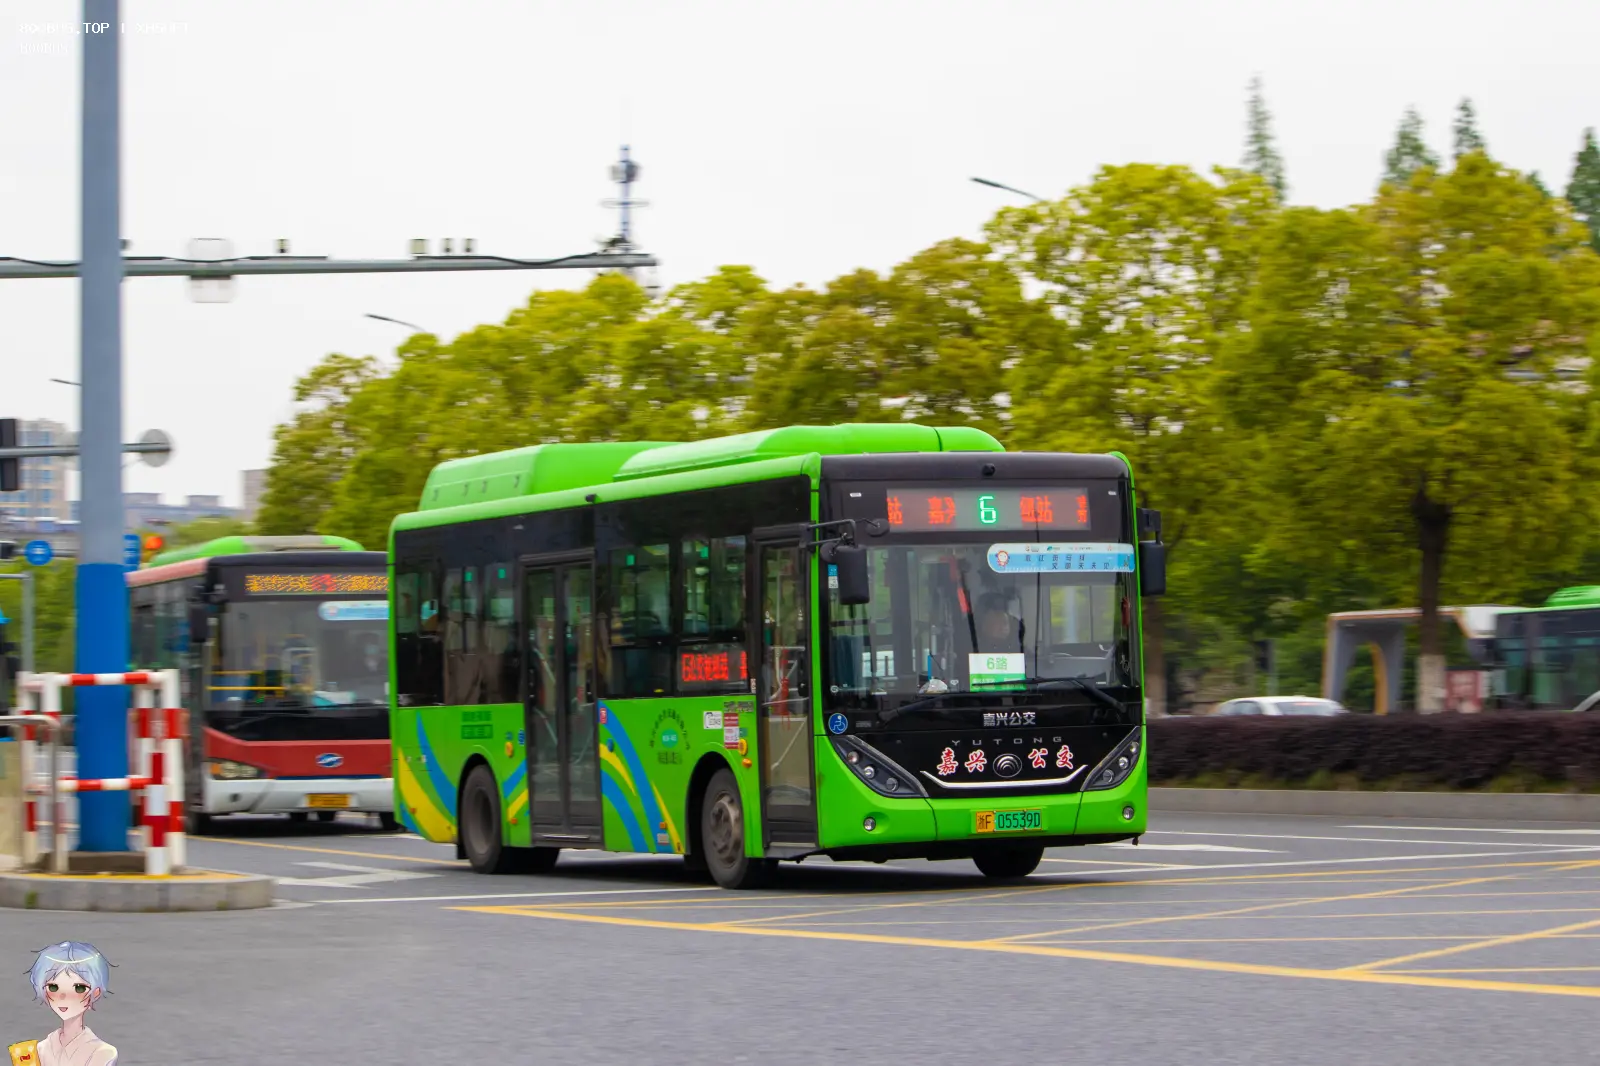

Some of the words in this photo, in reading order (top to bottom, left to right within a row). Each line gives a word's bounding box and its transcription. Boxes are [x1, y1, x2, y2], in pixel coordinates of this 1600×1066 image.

[979, 495, 997, 524] 6
[983, 711, 1036, 727] 嘉兴公交
[952, 736, 1062, 746] YUTONG
